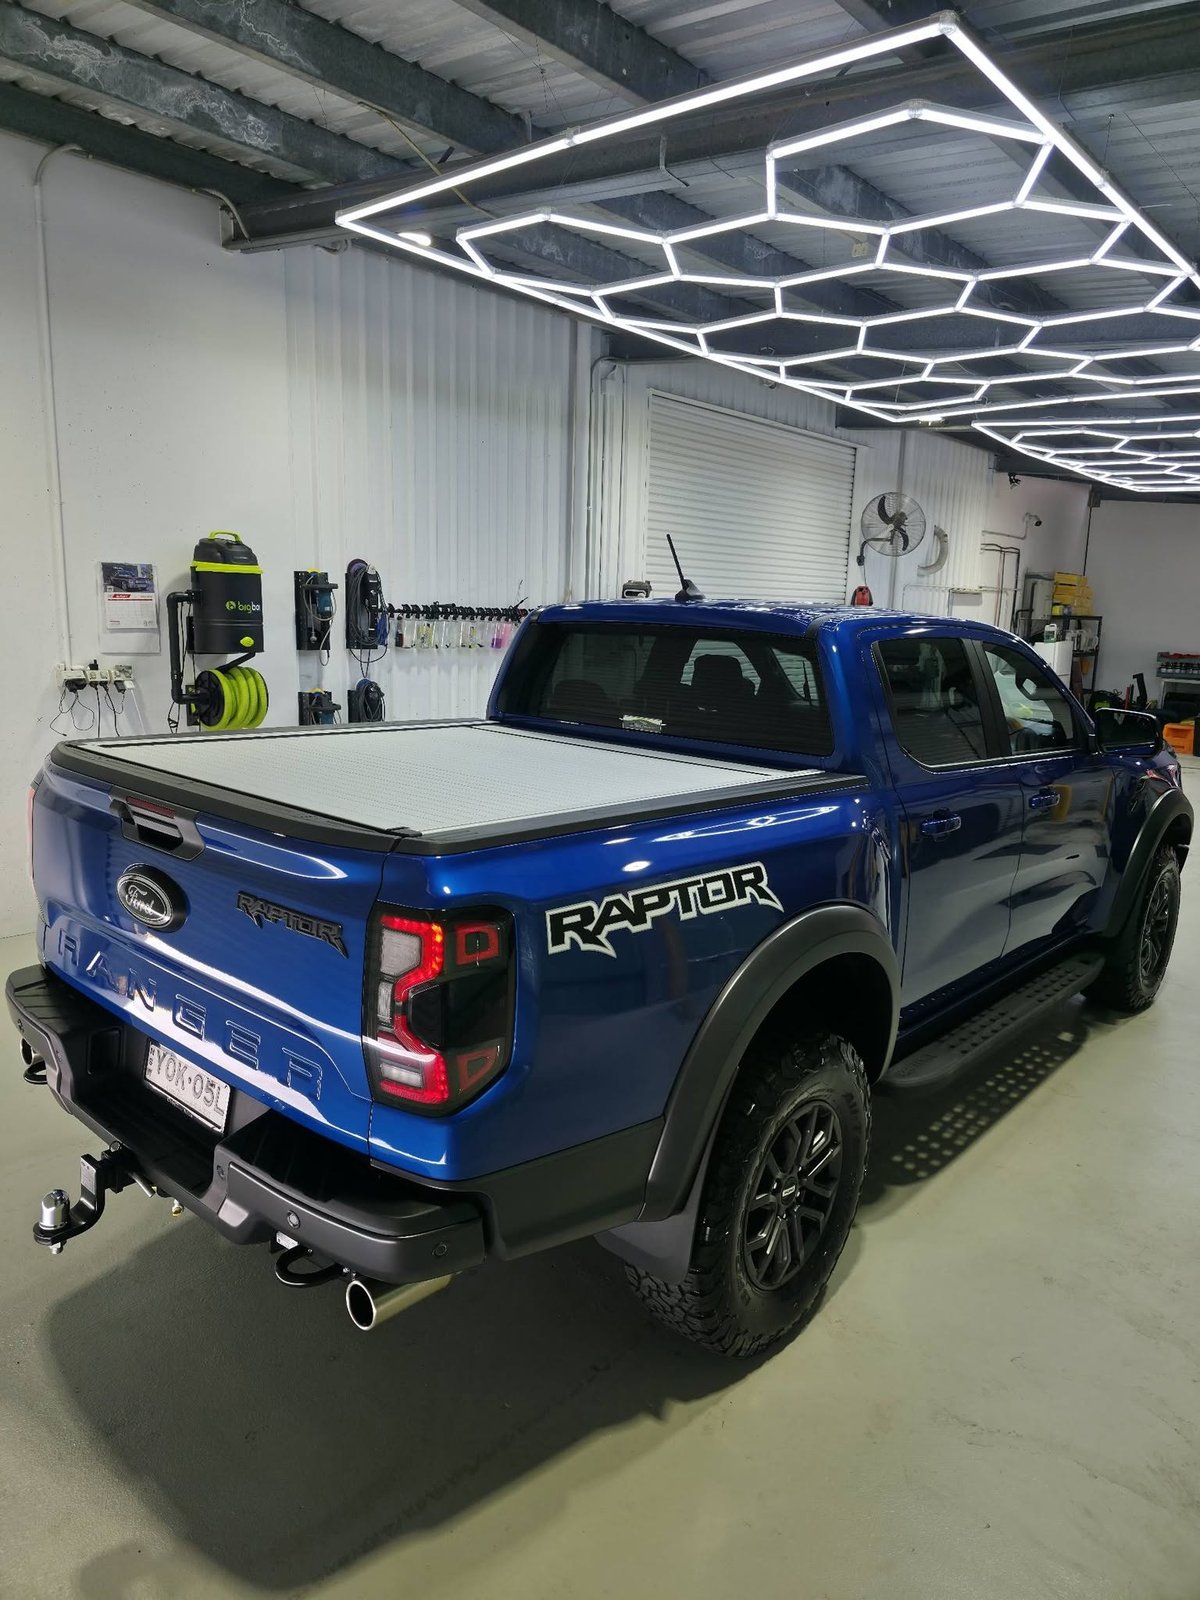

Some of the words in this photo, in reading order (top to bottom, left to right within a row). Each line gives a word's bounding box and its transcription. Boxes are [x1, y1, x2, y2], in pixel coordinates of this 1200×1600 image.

[238, 601, 261, 614] bigbo
[235, 890, 349, 959] RAPTOR
[546, 861, 784, 959] RAPTOR
[58, 927, 323, 1101] RANGER
